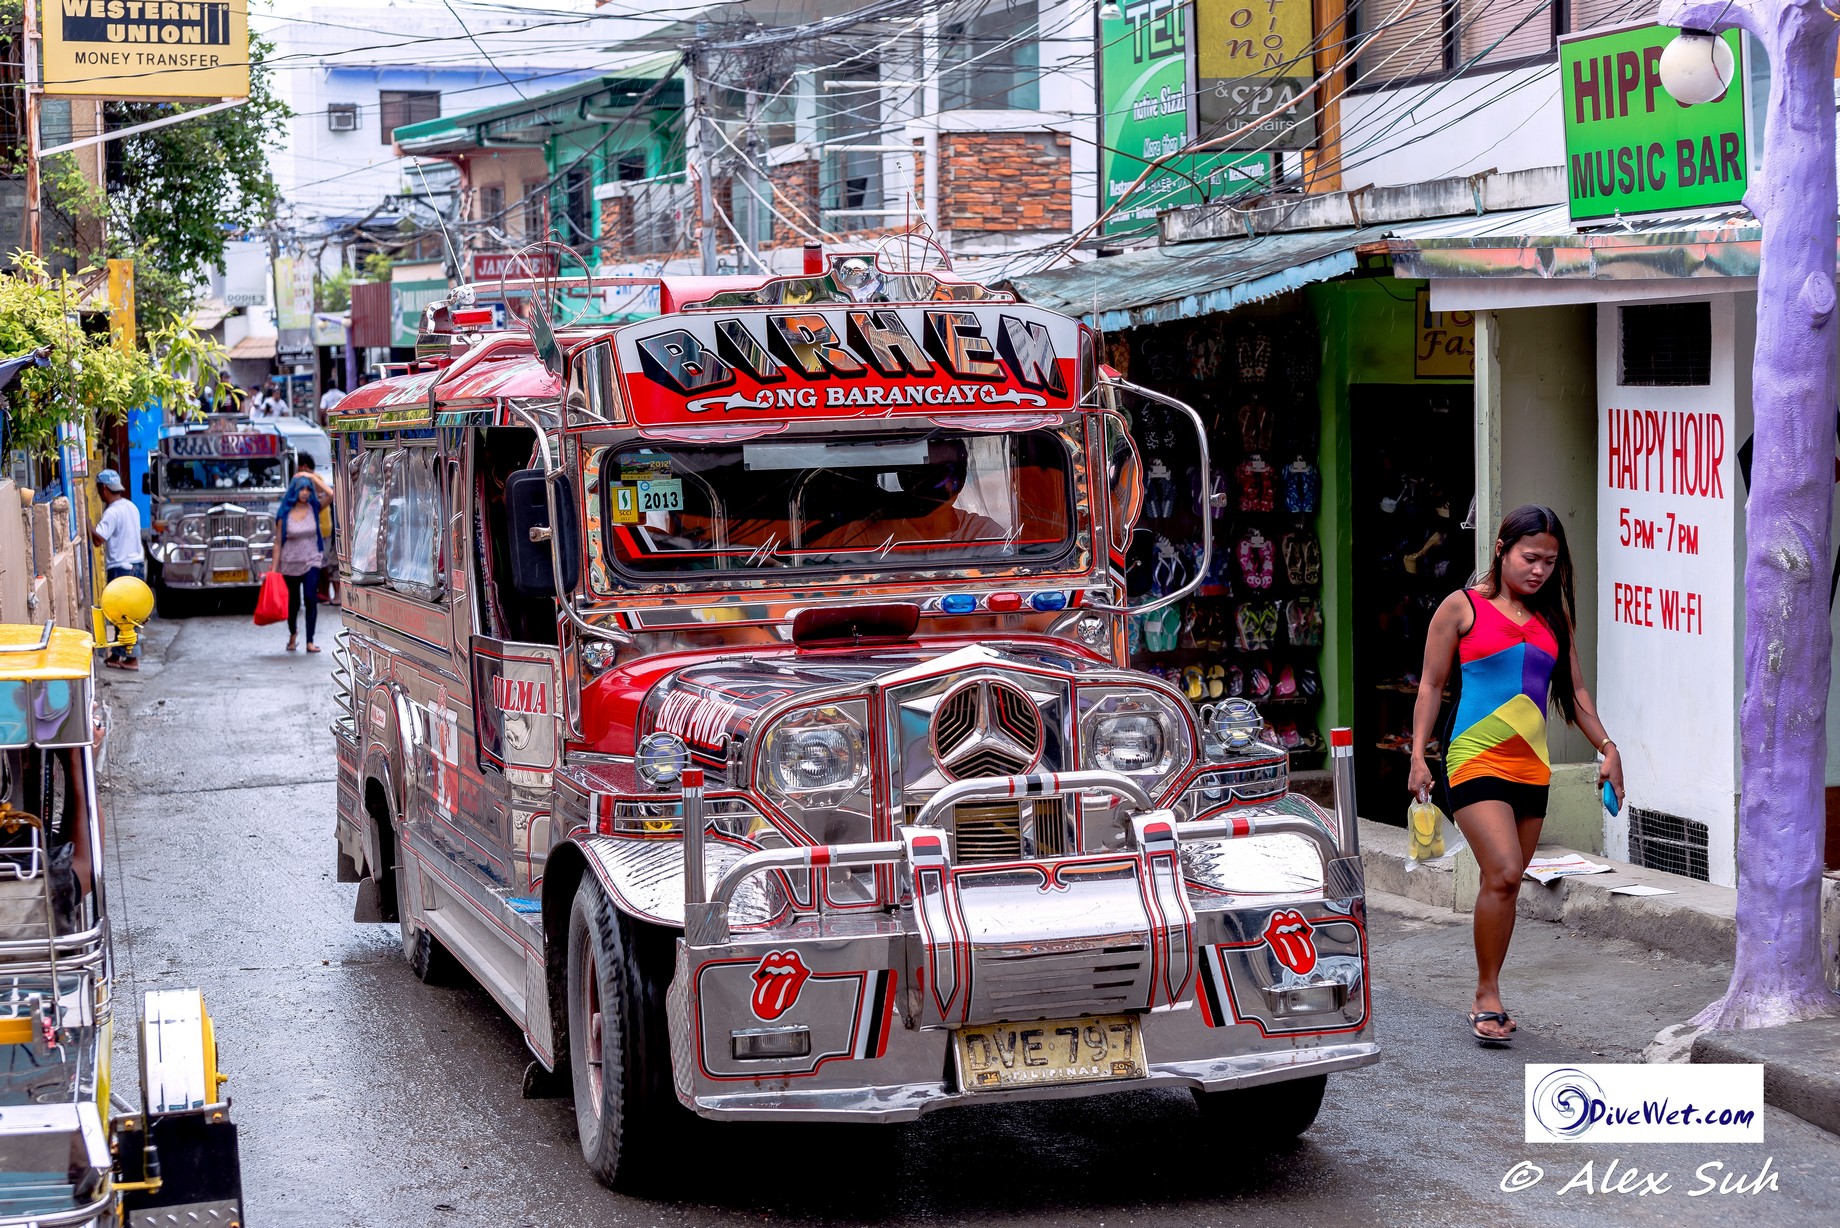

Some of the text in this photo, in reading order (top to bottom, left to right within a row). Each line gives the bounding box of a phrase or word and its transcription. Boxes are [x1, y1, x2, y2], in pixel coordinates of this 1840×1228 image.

[62, 0, 201, 20] WESTERN
[107, 24, 200, 43] UNION
[75, 51, 219, 67] MONEY TRANSFER
[1573, 45, 1728, 124] HIPP
[1229, 85, 1297, 117] SPA
[1226, 117, 1295, 132] Uptairs
[1572, 131, 1743, 199] MUSIC BAR
[637, 310, 1067, 398] BIRHEN
[826, 384, 980, 407] BARANGAY
[650, 460, 669, 468] 2012
[1608, 408, 1724, 499] HAPPY HOUR
[644, 491, 679, 509] 2013
[1614, 582, 1702, 635] FREE WI-FI
[965, 1025, 1133, 1070] DVE 797
